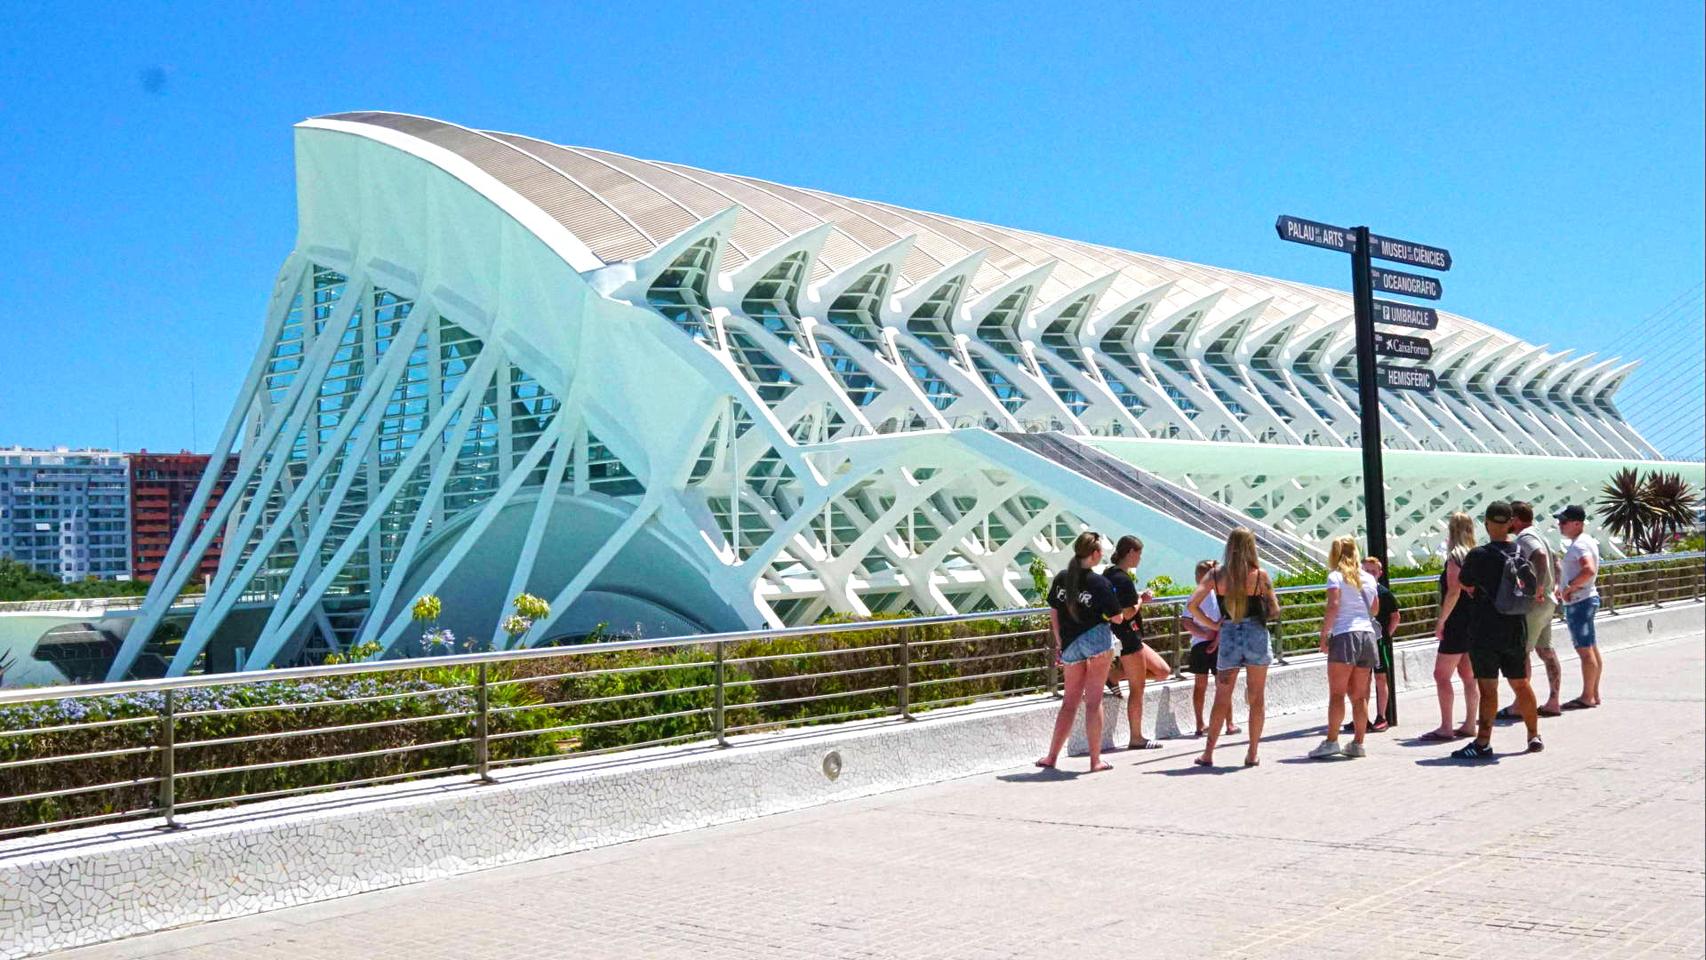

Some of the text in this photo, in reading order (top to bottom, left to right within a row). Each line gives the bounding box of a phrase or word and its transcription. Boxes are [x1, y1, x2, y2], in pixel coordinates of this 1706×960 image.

[1287, 221, 1315, 241] PALAU
[1323, 230, 1344, 248] ARTS
[1381, 241, 1407, 260] MUSEU
[1391, 307, 1429, 326] UMBRACLE
[1393, 339, 1429, 355] CaixaForum
